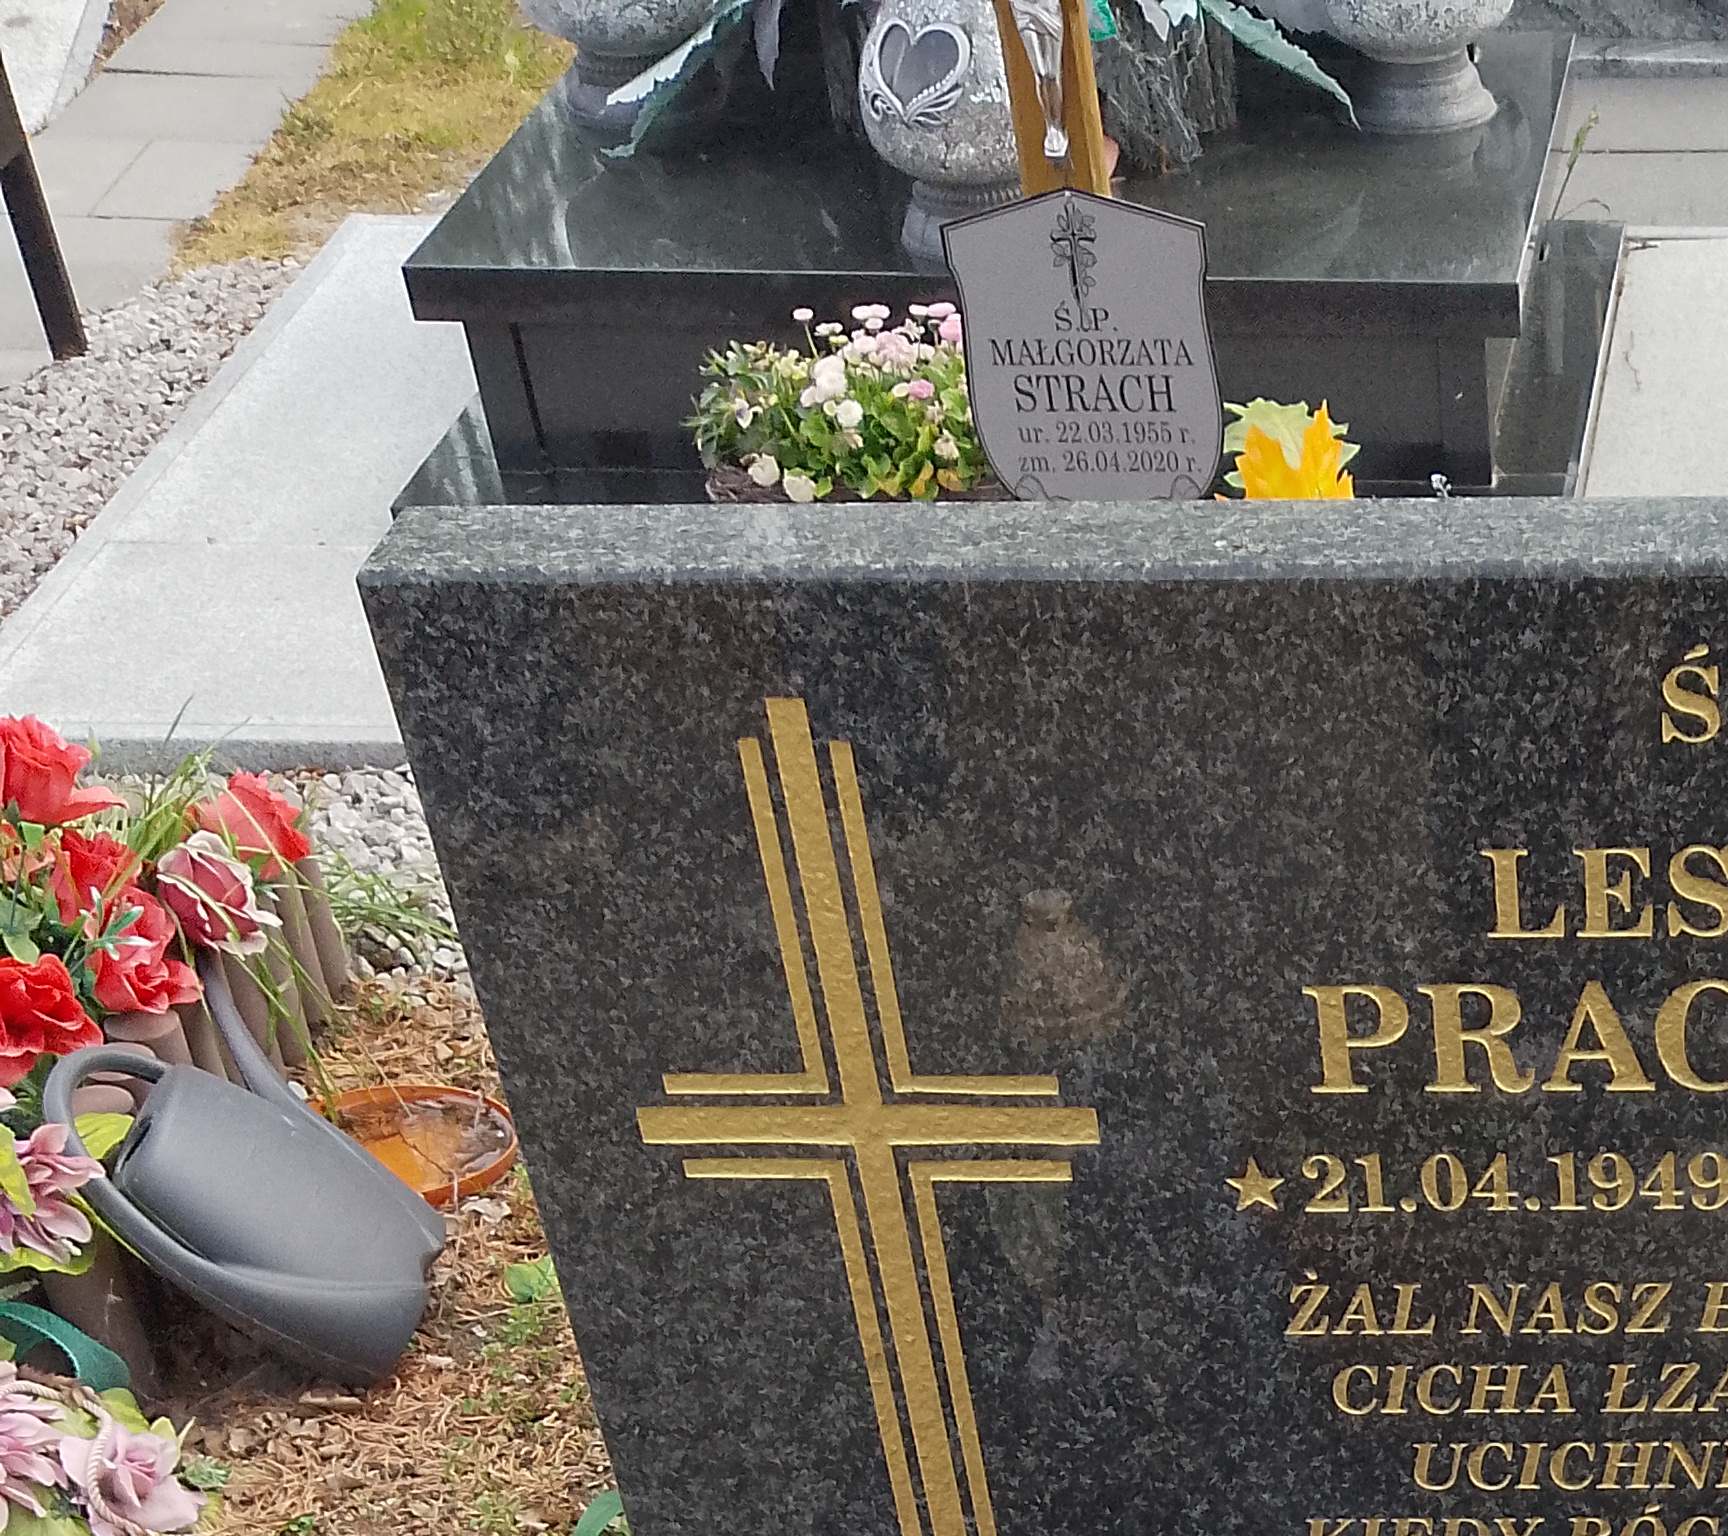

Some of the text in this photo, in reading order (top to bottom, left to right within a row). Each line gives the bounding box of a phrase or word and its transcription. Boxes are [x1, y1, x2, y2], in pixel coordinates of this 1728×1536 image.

[988, 338, 1195, 367] MAŁGORZATA
[1013, 373, 1177, 413] STRACH
[1017, 421, 1196, 445] ur. 22.03.1955 r.
[1017, 450, 1202, 474] zm. 26.04.2020 r.
[1286, 1271, 1437, 1338] ŻAL
[1461, 1281, 1672, 1336] NASZ
[1331, 1363, 1574, 1416] CICHA
